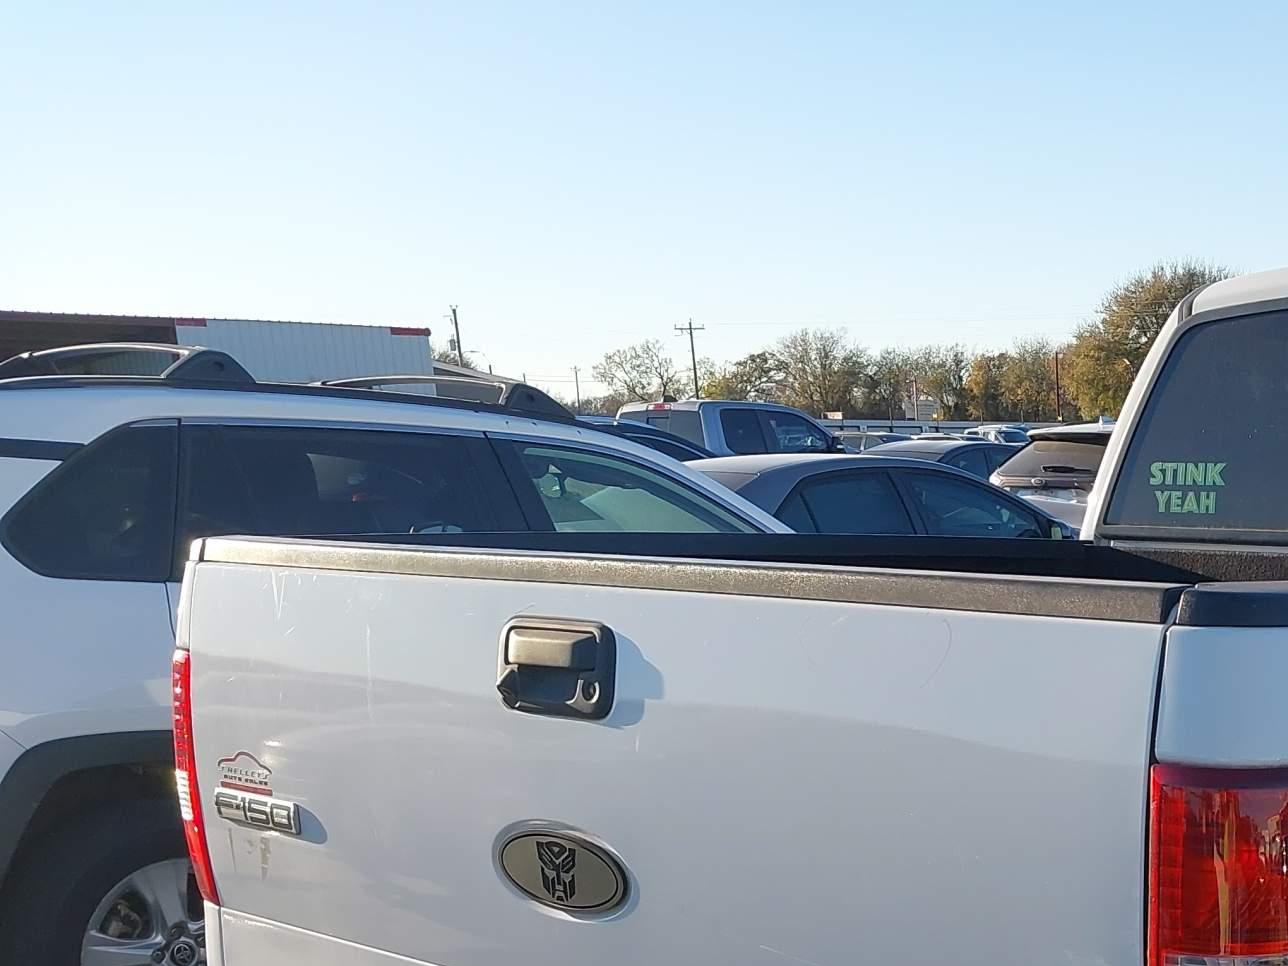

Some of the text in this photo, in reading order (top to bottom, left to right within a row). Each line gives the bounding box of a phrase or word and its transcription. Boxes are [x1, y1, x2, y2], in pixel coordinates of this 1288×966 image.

[1150, 462, 1226, 486] STINK
[1154, 491, 1217, 513] YEAH
[215, 792, 293, 830] F-150
